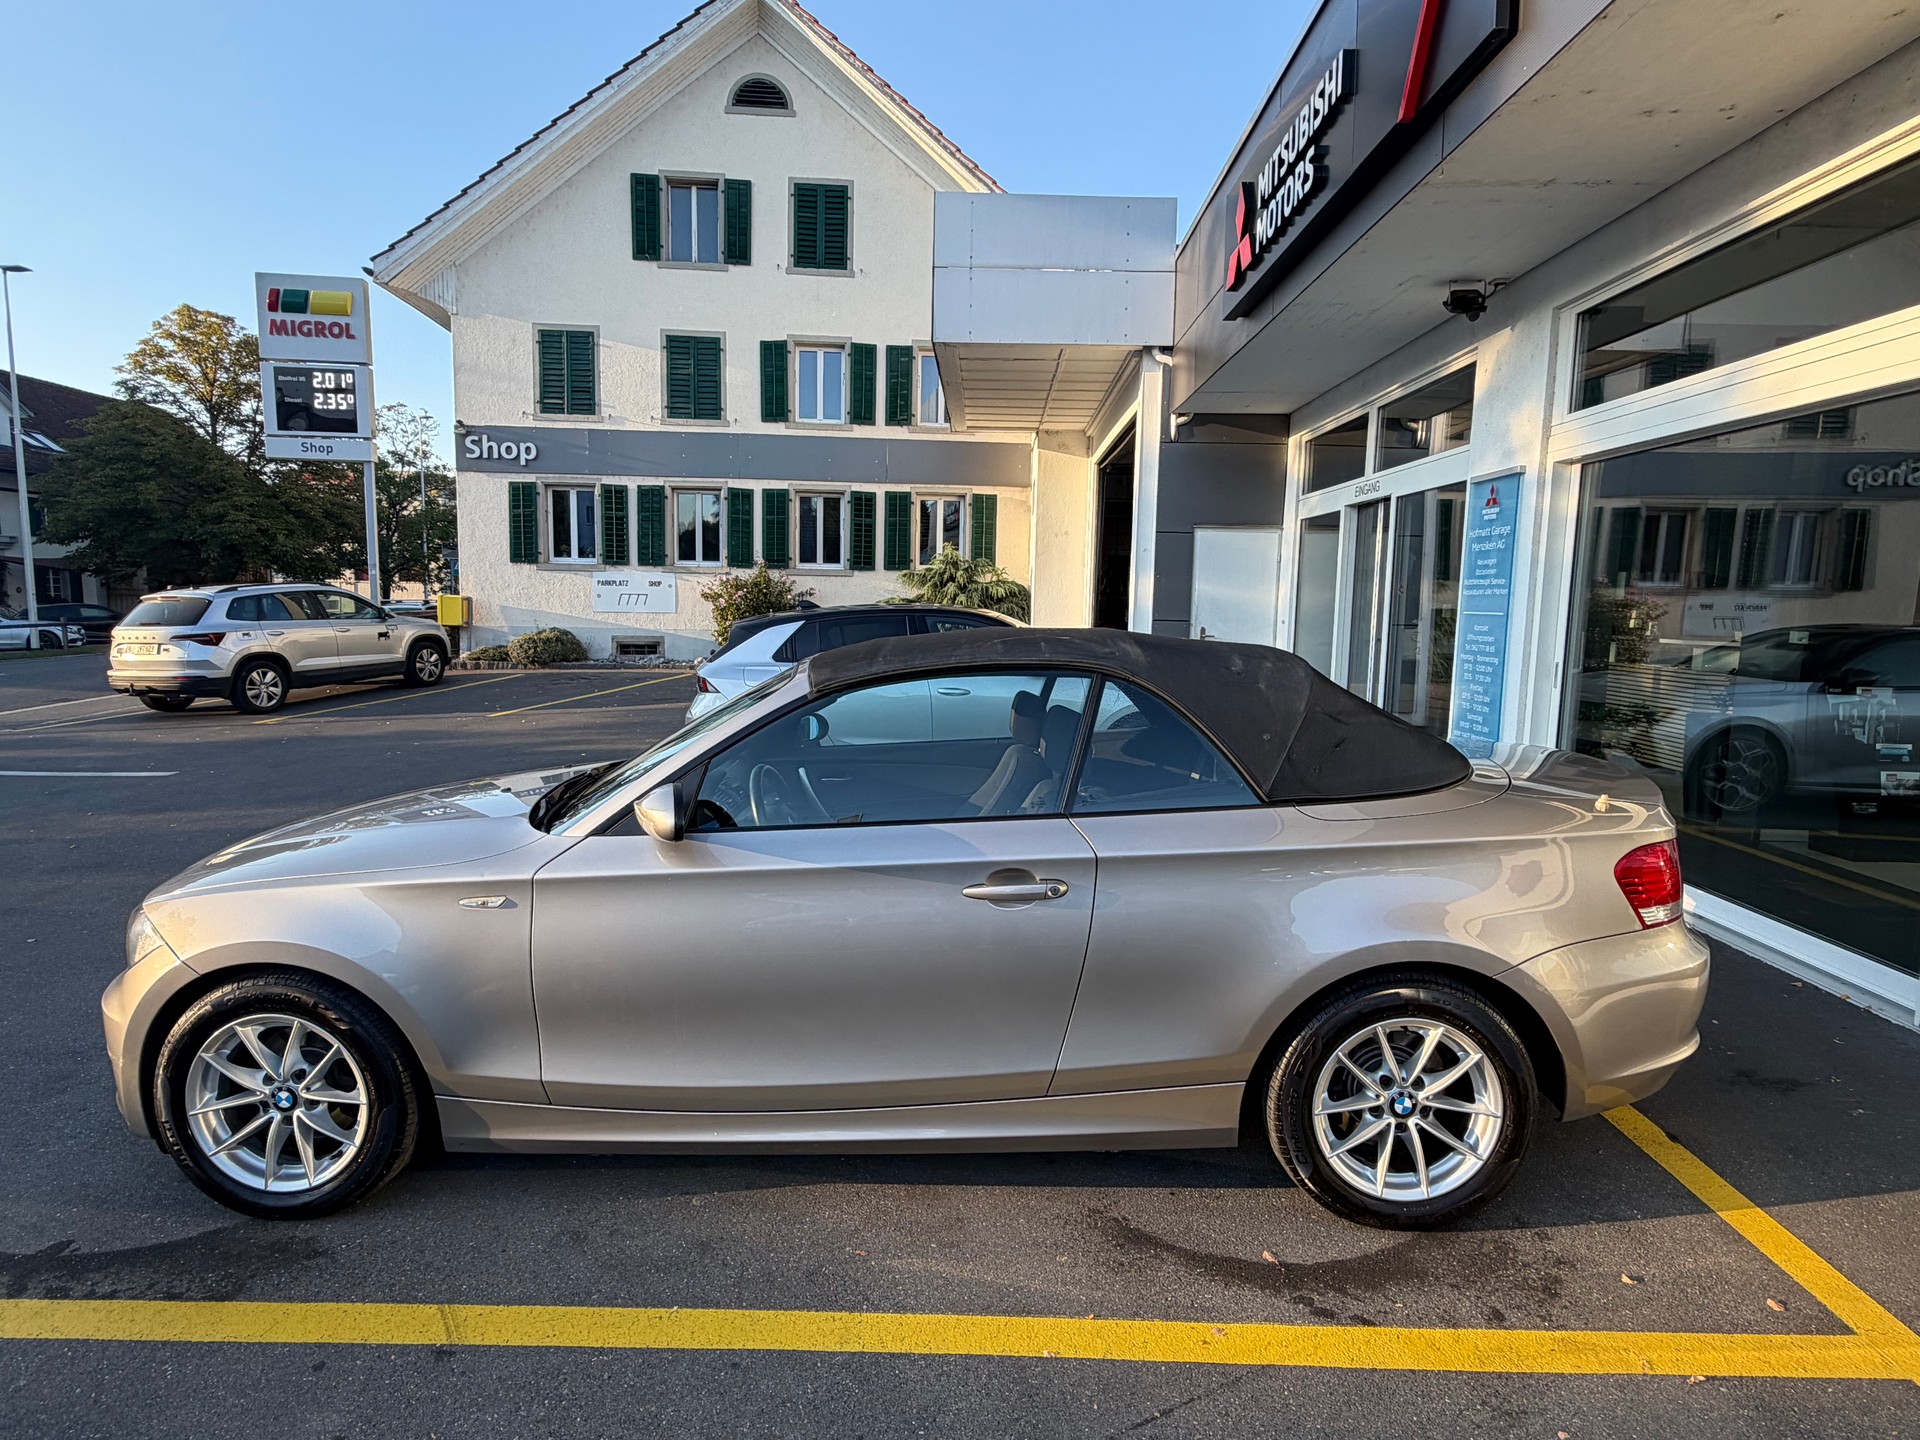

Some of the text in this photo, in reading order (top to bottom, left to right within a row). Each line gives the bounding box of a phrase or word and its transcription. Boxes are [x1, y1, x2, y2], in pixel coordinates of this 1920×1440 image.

[1257, 48, 1344, 210] MITSUBISHI
[1255, 144, 1315, 254] MOTORS
[268, 318, 357, 339] MIGROL
[301, 442, 334, 456] Shop
[464, 434, 537, 466] Shop
[1355, 480, 1381, 498] EINGANG
[1491, 525, 1511, 536] Garage
[597, 579, 663, 588] PARKPLATZ SHOP
